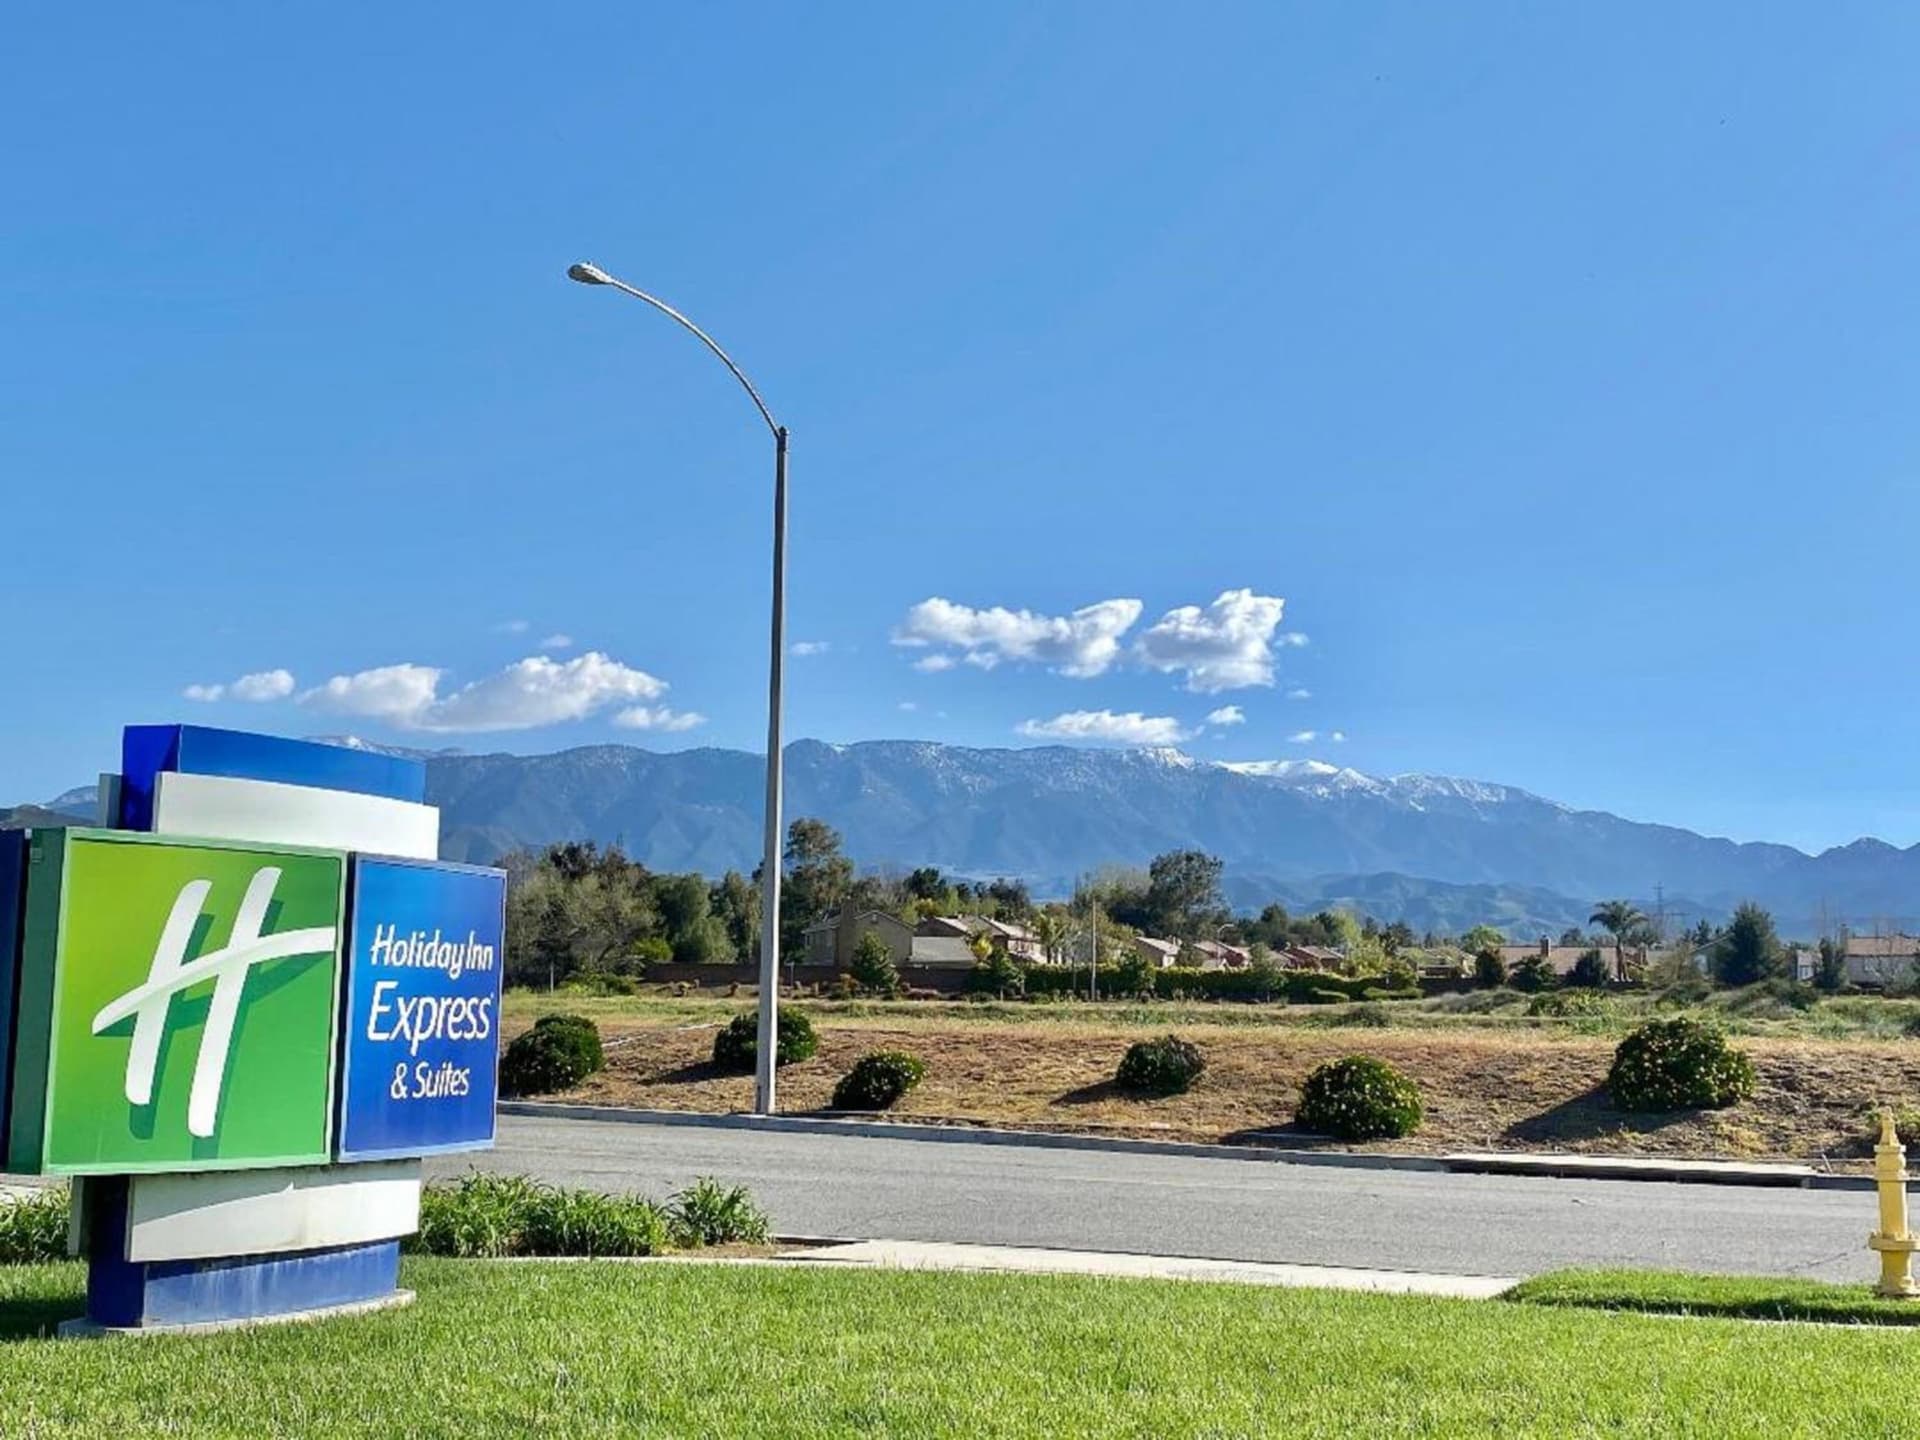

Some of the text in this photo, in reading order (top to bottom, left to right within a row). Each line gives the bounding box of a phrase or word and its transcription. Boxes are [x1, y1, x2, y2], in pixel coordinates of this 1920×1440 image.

[371, 924, 493, 979] Holiday Inn
[367, 981, 491, 1055] Express
[391, 1061, 470, 1099] & Suites
